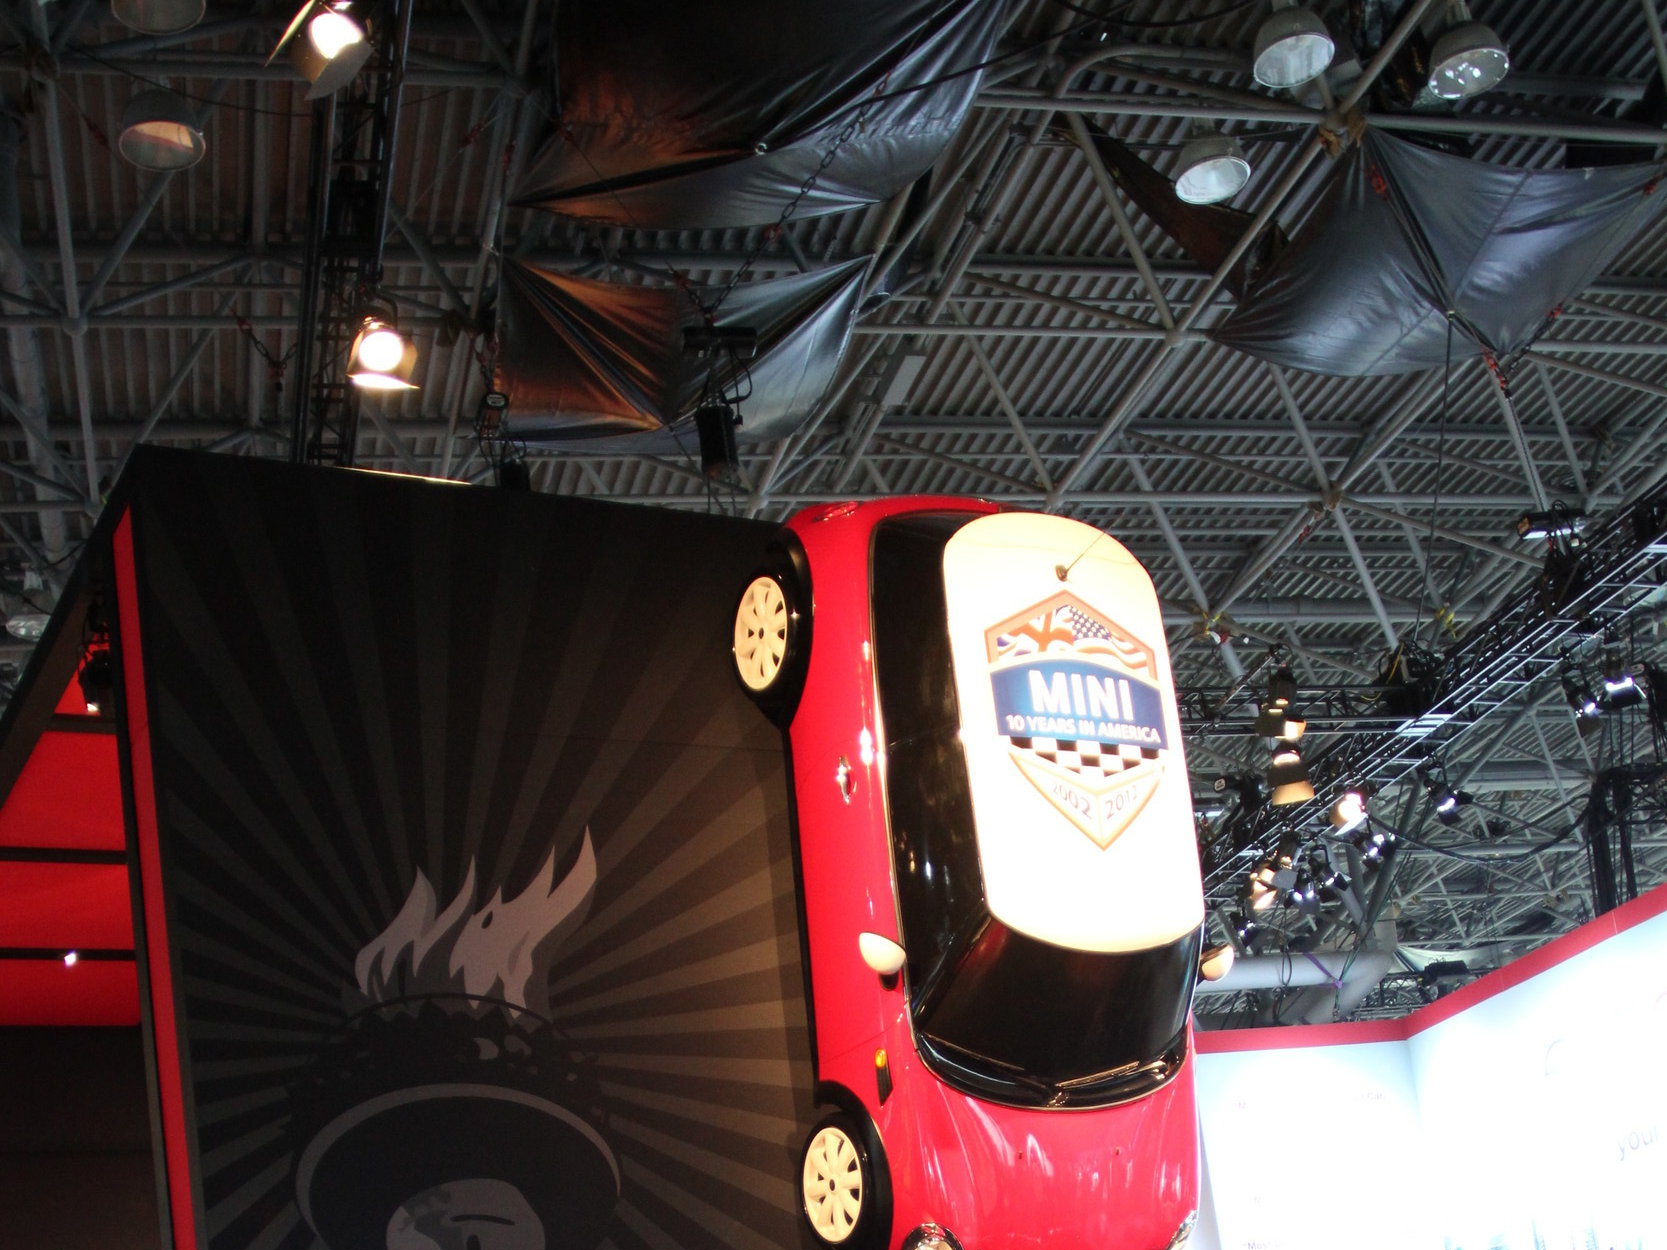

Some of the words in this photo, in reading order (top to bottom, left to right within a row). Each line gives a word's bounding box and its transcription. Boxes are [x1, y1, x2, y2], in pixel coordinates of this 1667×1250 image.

[1028, 669, 1134, 721] MINI
[1006, 714, 1026, 732] 10
[1026, 715, 1077, 735] YEARS
[1077, 719, 1097, 736] IN
[1097, 721, 1162, 744] AMERICA
[1053, 784, 1092, 820] 2002
